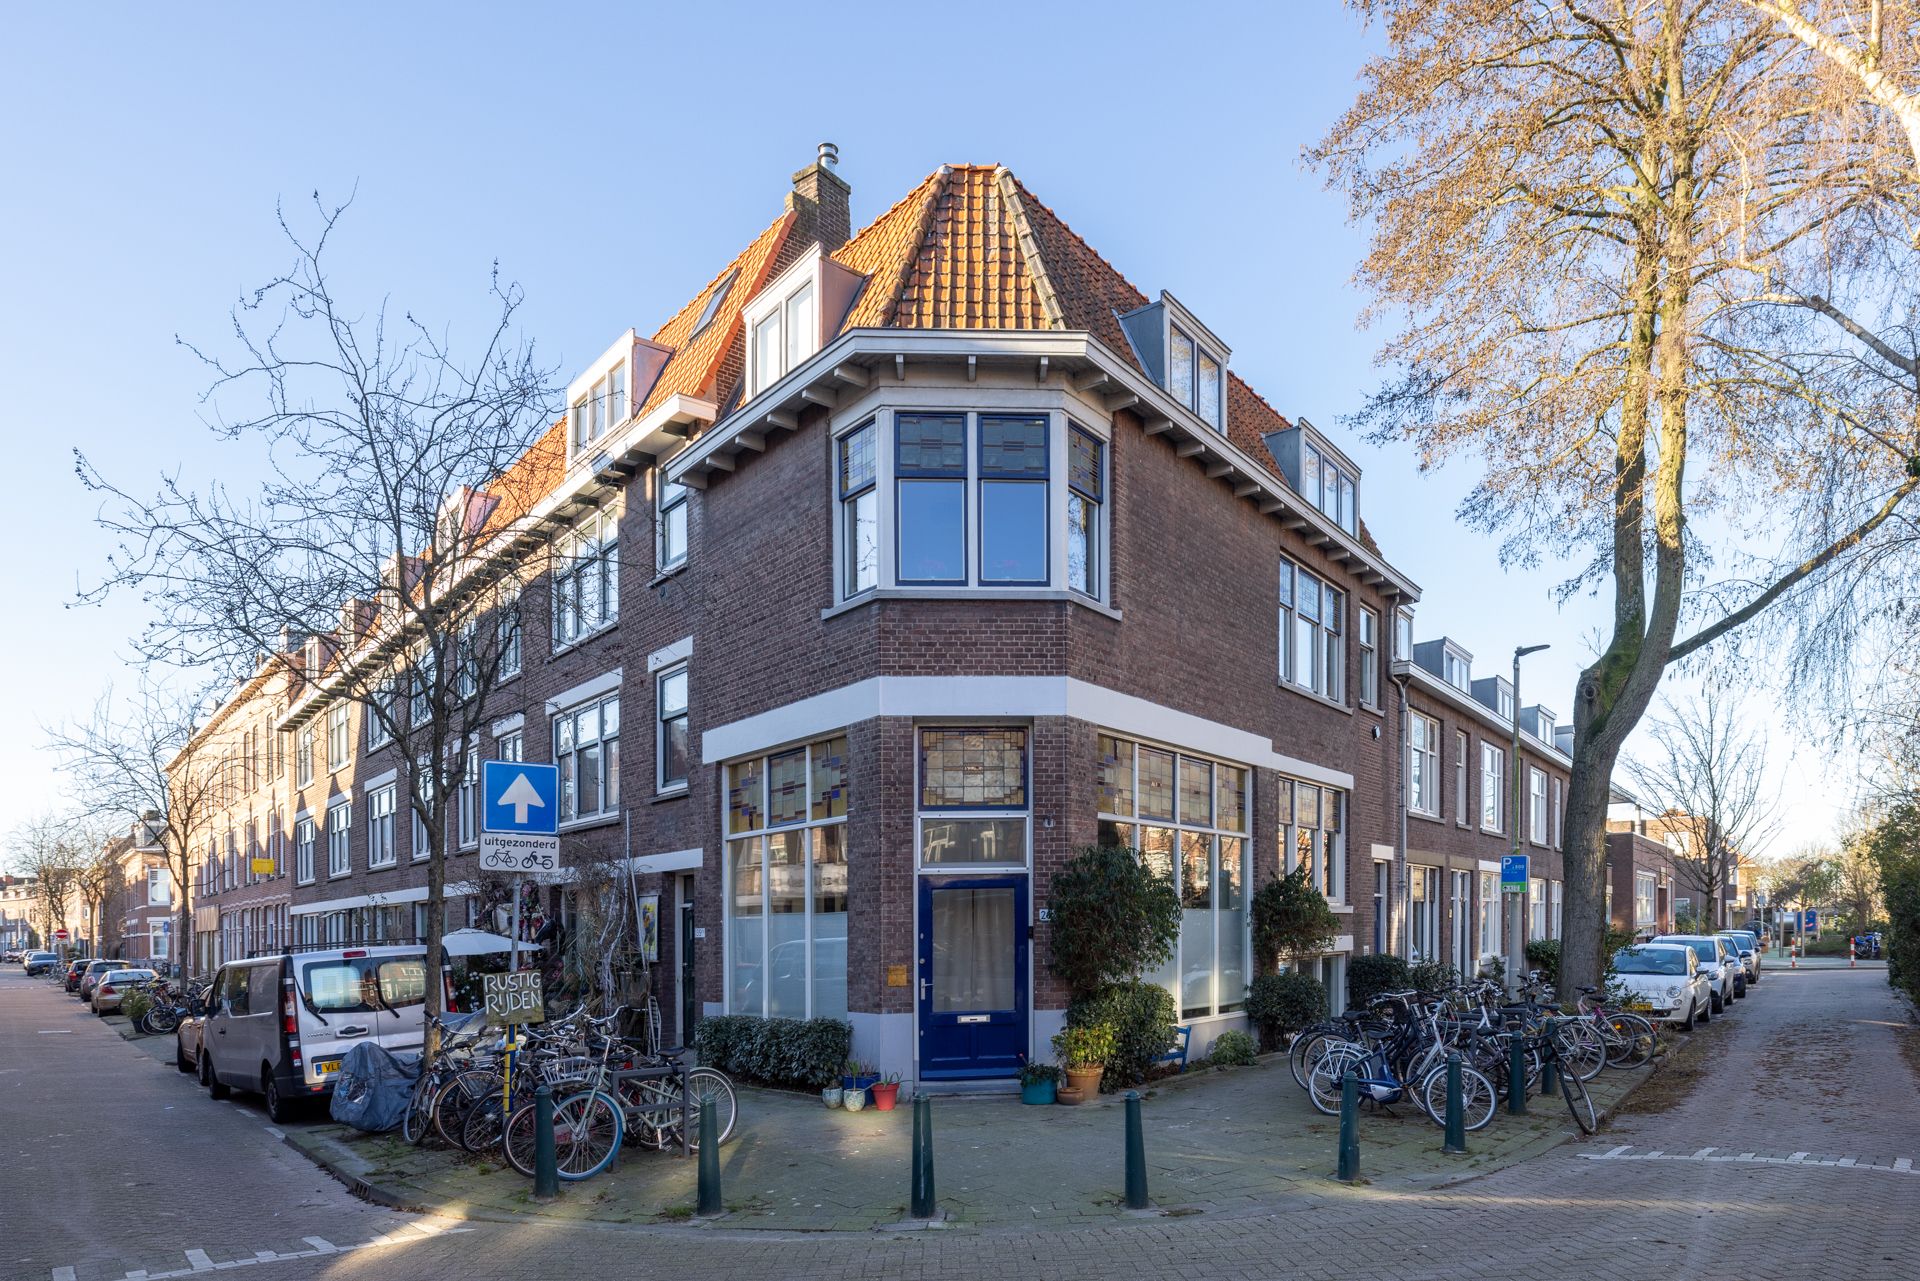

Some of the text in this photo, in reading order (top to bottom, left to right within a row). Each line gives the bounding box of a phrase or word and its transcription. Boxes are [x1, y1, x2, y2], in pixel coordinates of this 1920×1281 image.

[484, 837, 556, 849] uitgezonderd
[1502, 857, 1512, 870] P
[484, 972, 541, 993] RUSTIG
[485, 990, 542, 1017] RIJDEN
